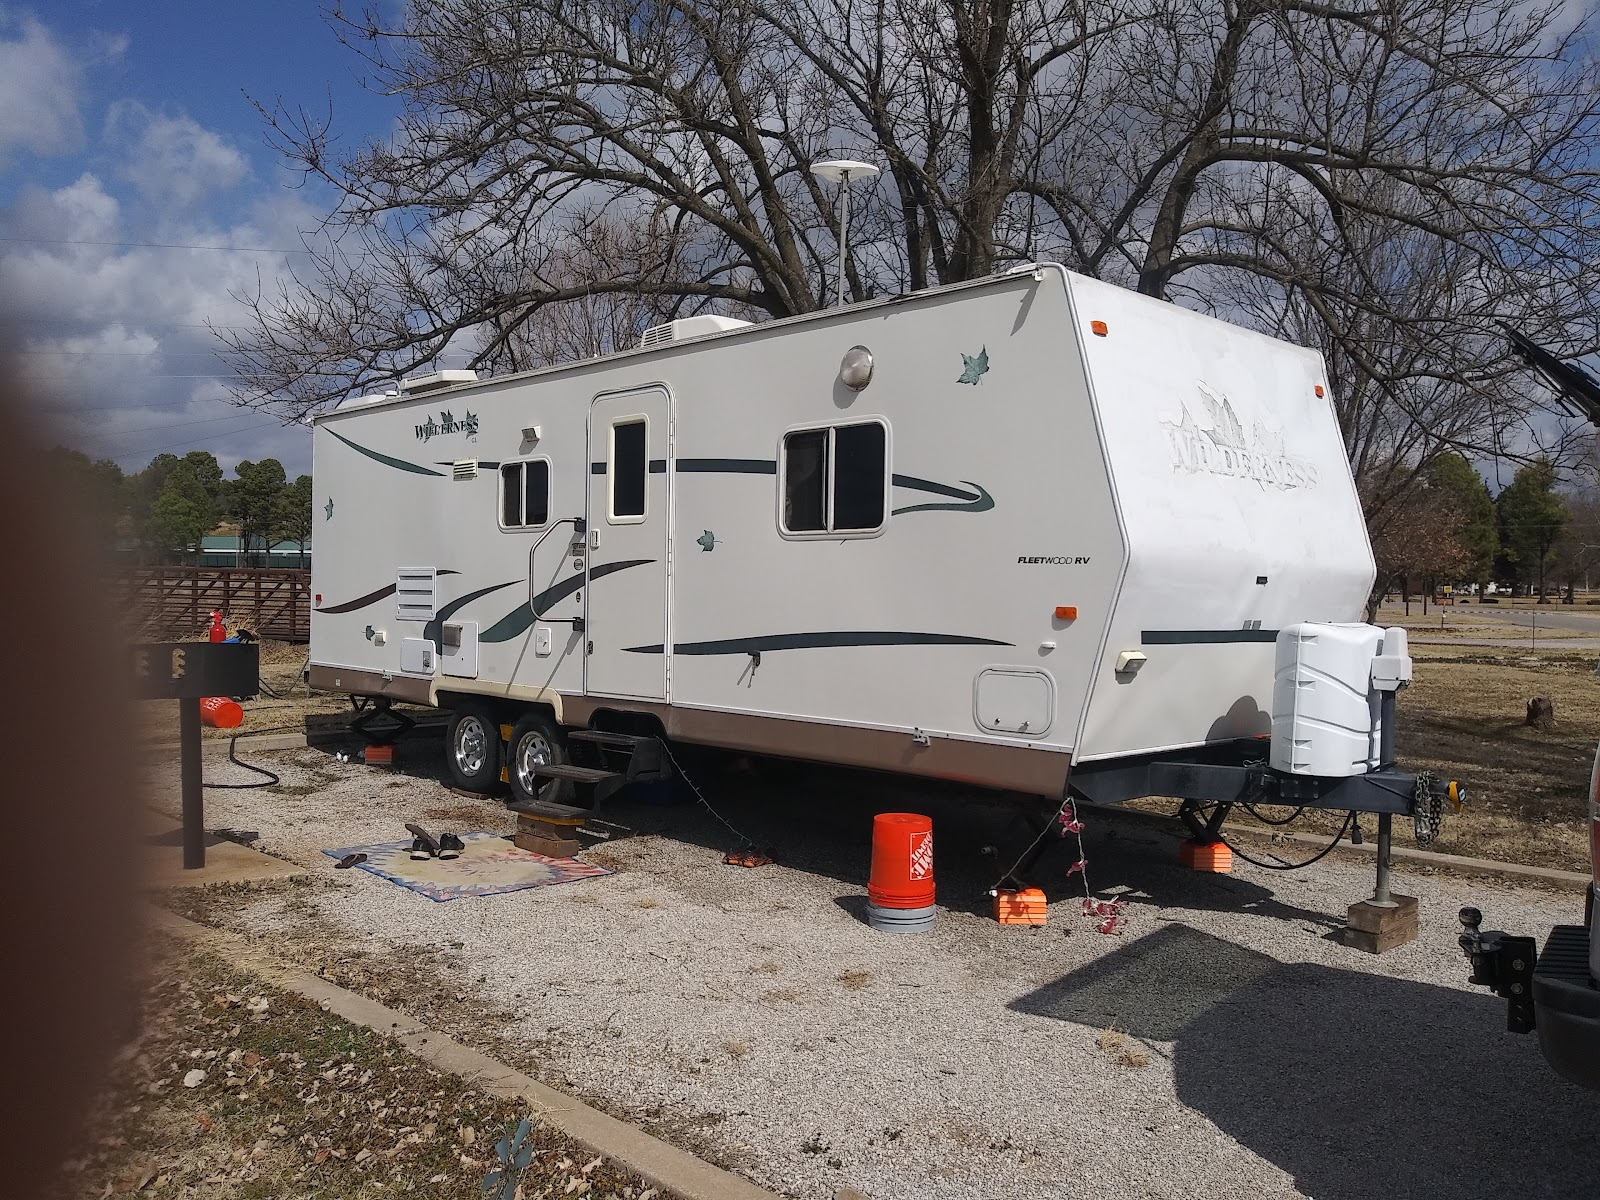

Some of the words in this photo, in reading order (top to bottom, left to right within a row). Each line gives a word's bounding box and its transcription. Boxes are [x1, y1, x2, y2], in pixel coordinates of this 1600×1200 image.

[414, 418, 479, 440] WILDERNESS
[1017, 556, 1073, 565] FLEETWOOD
[1074, 556, 1091, 565] RV
[910, 843, 933, 880] OME
